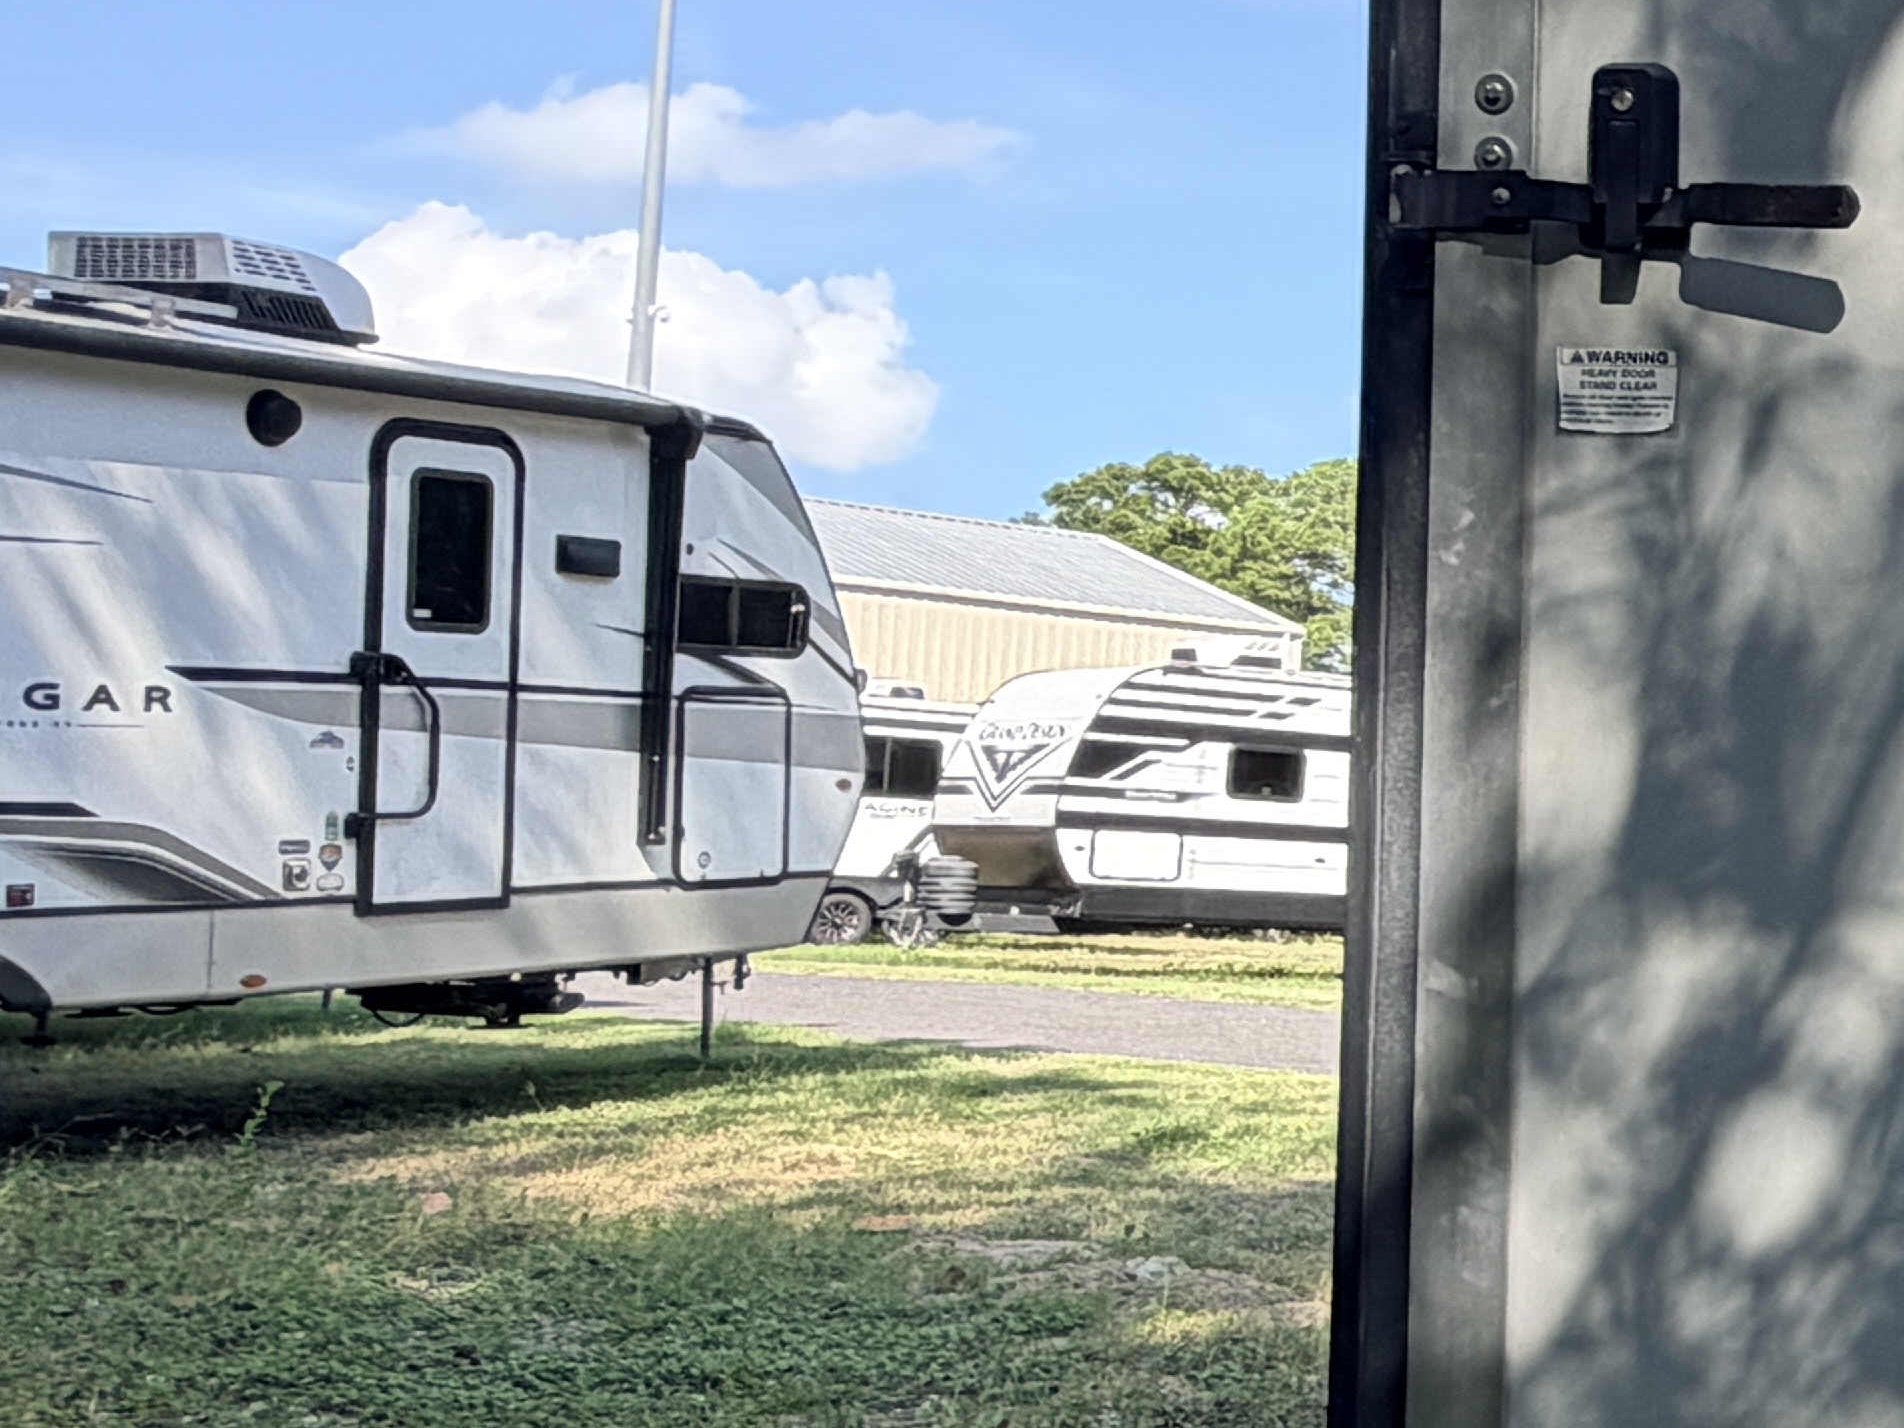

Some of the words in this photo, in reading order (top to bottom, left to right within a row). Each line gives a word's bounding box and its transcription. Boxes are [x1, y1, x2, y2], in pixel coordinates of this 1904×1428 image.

[1587, 350, 1669, 364] WARNING
[1620, 381, 1657, 391] CLEAR
[22, 682, 173, 713] GAR
